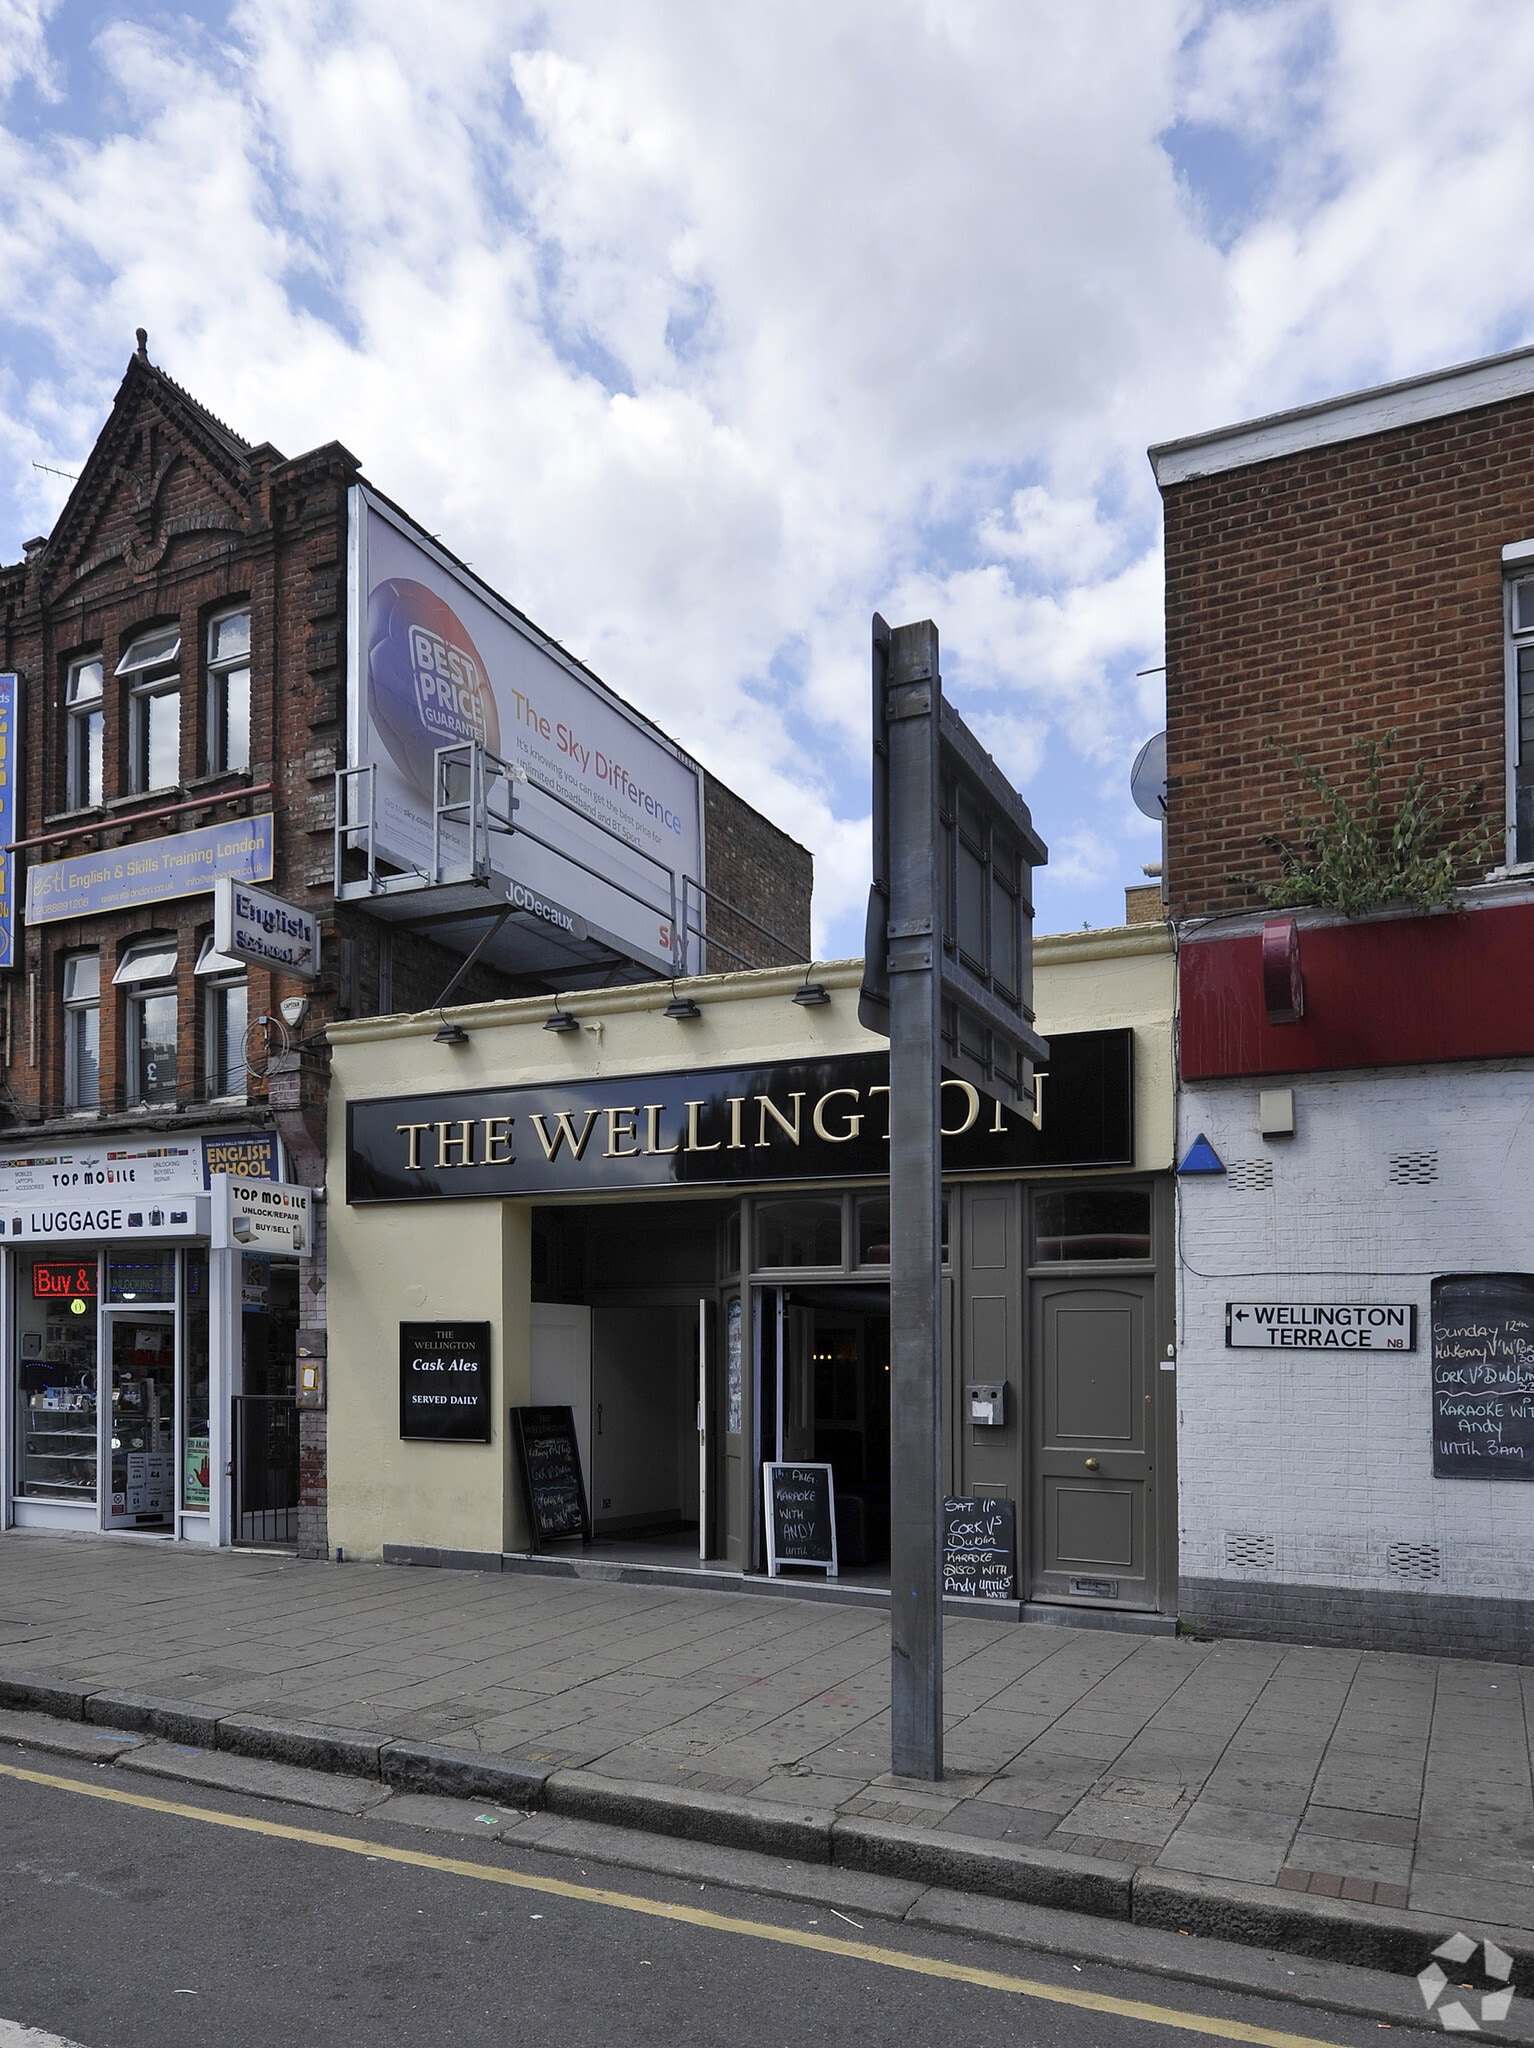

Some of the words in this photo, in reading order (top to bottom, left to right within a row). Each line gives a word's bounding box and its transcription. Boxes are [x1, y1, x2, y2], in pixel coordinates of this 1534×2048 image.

[415, 635, 475, 693] BEST
[420, 672, 482, 724] PRICE
[511, 688, 551, 741] The
[556, 723, 590, 774] Sky
[595, 750, 681, 836] Difference
[516, 737, 529, 754] It's
[530, 746, 563, 780] knowing
[564, 772, 578, 788] you
[579, 782, 592, 797] can
[593, 792, 605, 807] get
[606, 799, 618, 815] the
[619, 808, 635, 827] best
[635, 821, 652, 841] price
[652, 831, 662, 845] for
[384, 797, 395, 810] Go
[395, 803, 403, 814] to
[556, 784, 597, 818] broadband
[597, 811, 612, 828] and
[612, 820, 621, 833] BT
[69, 868, 110, 889] English
[114, 864, 124, 879] &
[126, 857, 159, 876] Skills
[162, 848, 213, 868] Training
[217, 838, 265, 858] London
[505, 882, 574, 932] JCDecaux
[236, 893, 313, 942] English
[396, 1117, 515, 1170] THE
[207, 1145, 271, 1163] ENGLISH
[209, 1160, 270, 1177] SCHOOL
[53, 1174, 78, 1187] TOP
[233, 1187, 258, 1201] TOP
[32, 1209, 123, 1233] LUGGAGE
[242, 1207, 299, 1221] UNLOCK/REPAIR
[256, 1223, 291, 1235] BUY/SELL
[37, 1269, 71, 1296] Buy
[76, 1268, 91, 1291] &
[1254, 1307, 1404, 1326] WELLINGTON
[435, 1331, 454, 1339] THE
[1267, 1328, 1372, 1347] TERRACE
[1387, 1339, 1404, 1349] N8
[414, 1341, 476, 1350] WELLINGTON
[412, 1358, 445, 1371] Cask
[448, 1359, 478, 1372] Ales
[412, 1395, 448, 1405] SERVED
[450, 1396, 478, 1405] DAILY
[1440, 1398, 1504, 1418] KARAOKE
[1458, 1418, 1502, 1443] Andy
[776, 1490, 816, 1502] KARAOKE
[779, 1509, 804, 1520] WITH
[784, 1522, 815, 1541] ANDY
[947, 1551, 993, 1563] KARAOKE
